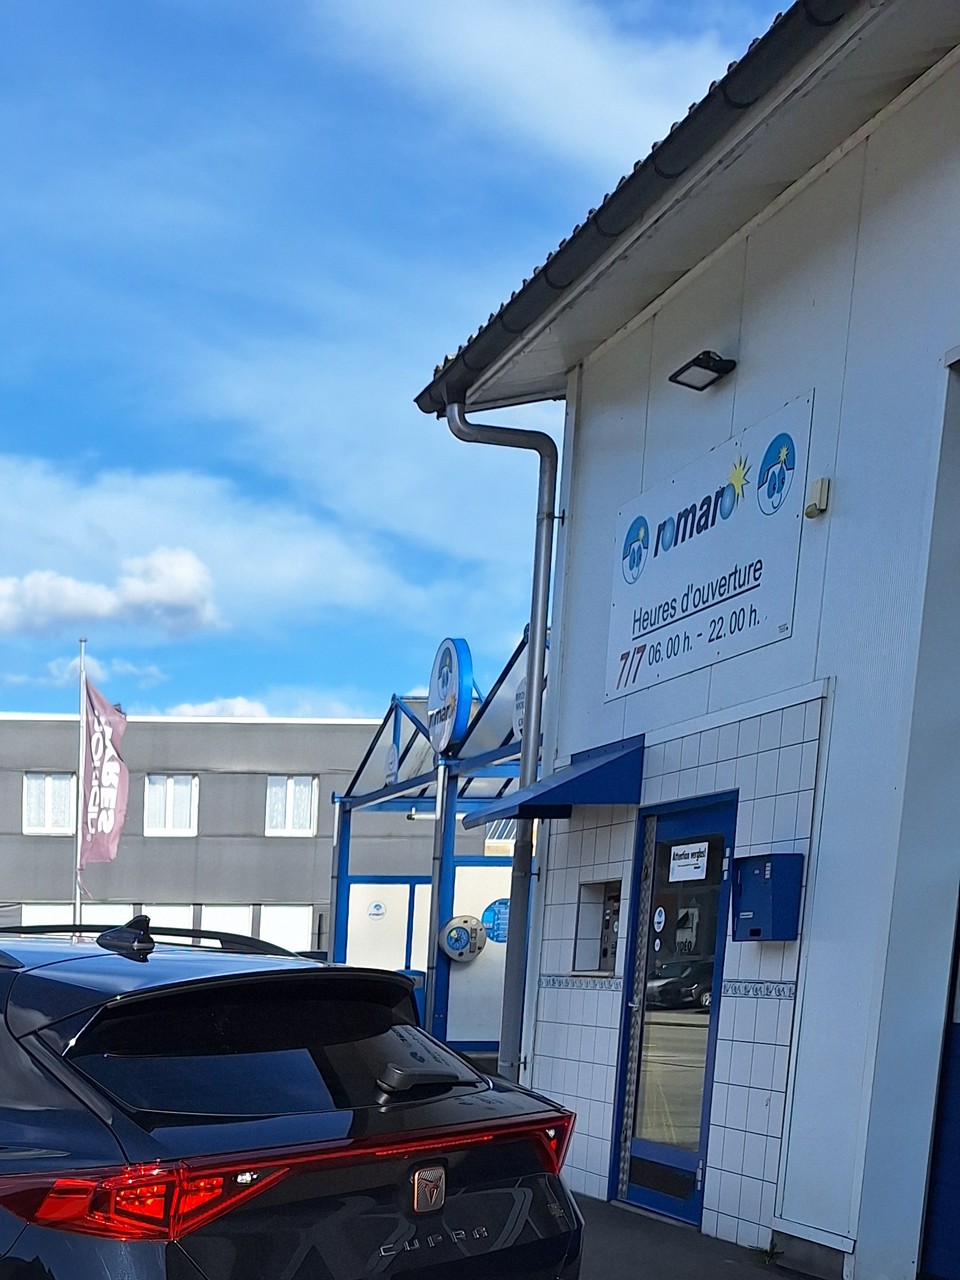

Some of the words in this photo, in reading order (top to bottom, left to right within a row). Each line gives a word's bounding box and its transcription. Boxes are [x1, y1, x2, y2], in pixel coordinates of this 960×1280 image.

[653, 483, 736, 558] romaro
[631, 597, 677, 635] Heures
[680, 558, 764, 613] d'ouverture
[616, 643, 647, 690] 7/7
[379, 1225, 489, 1257] CUPRA
